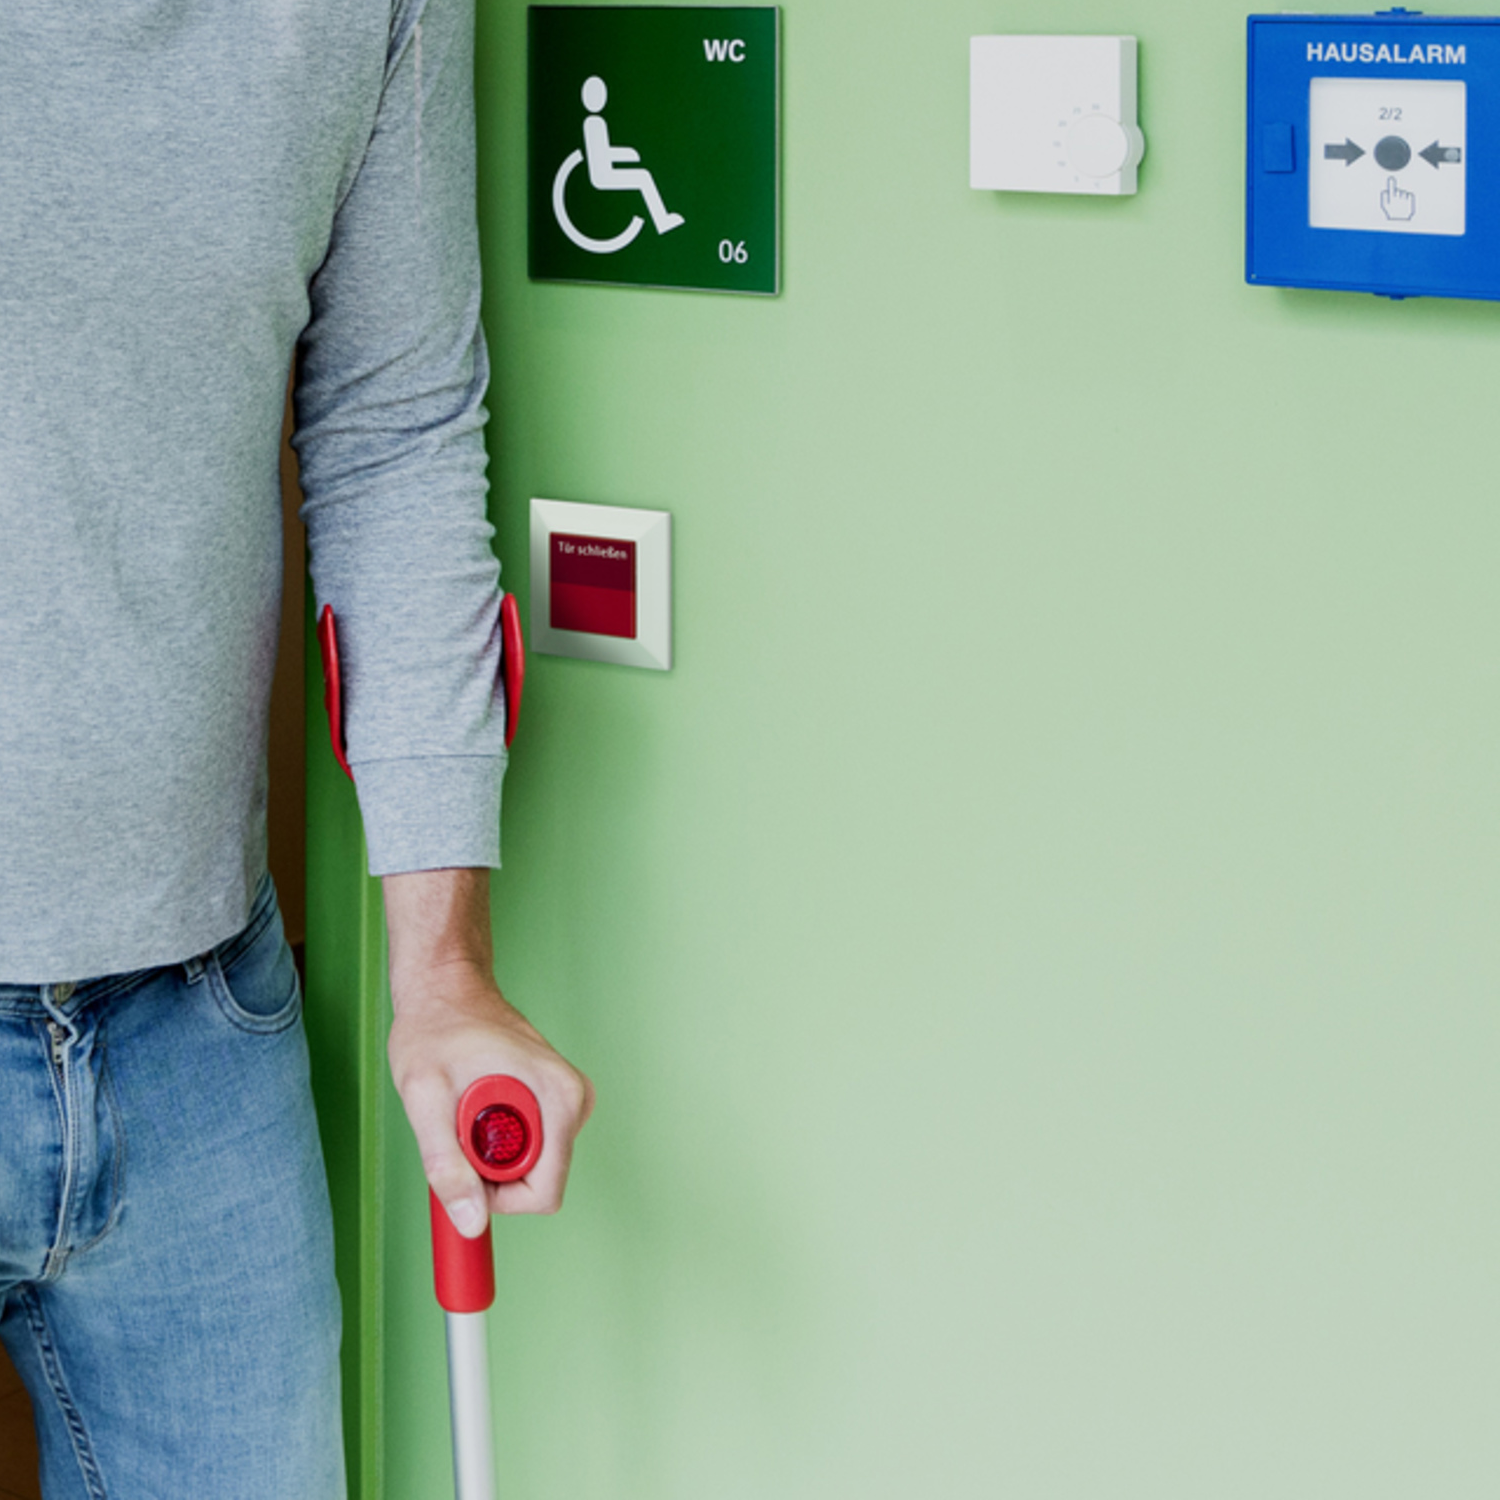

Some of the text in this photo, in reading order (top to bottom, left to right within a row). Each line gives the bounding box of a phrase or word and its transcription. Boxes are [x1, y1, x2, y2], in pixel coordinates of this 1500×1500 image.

[703, 38, 746, 63] WC
[1306, 42, 1467, 65] HAUSALARM
[1378, 106, 1403, 121] 2/2
[718, 239, 749, 263] 06
[558, 541, 627, 560] Tür schließen
